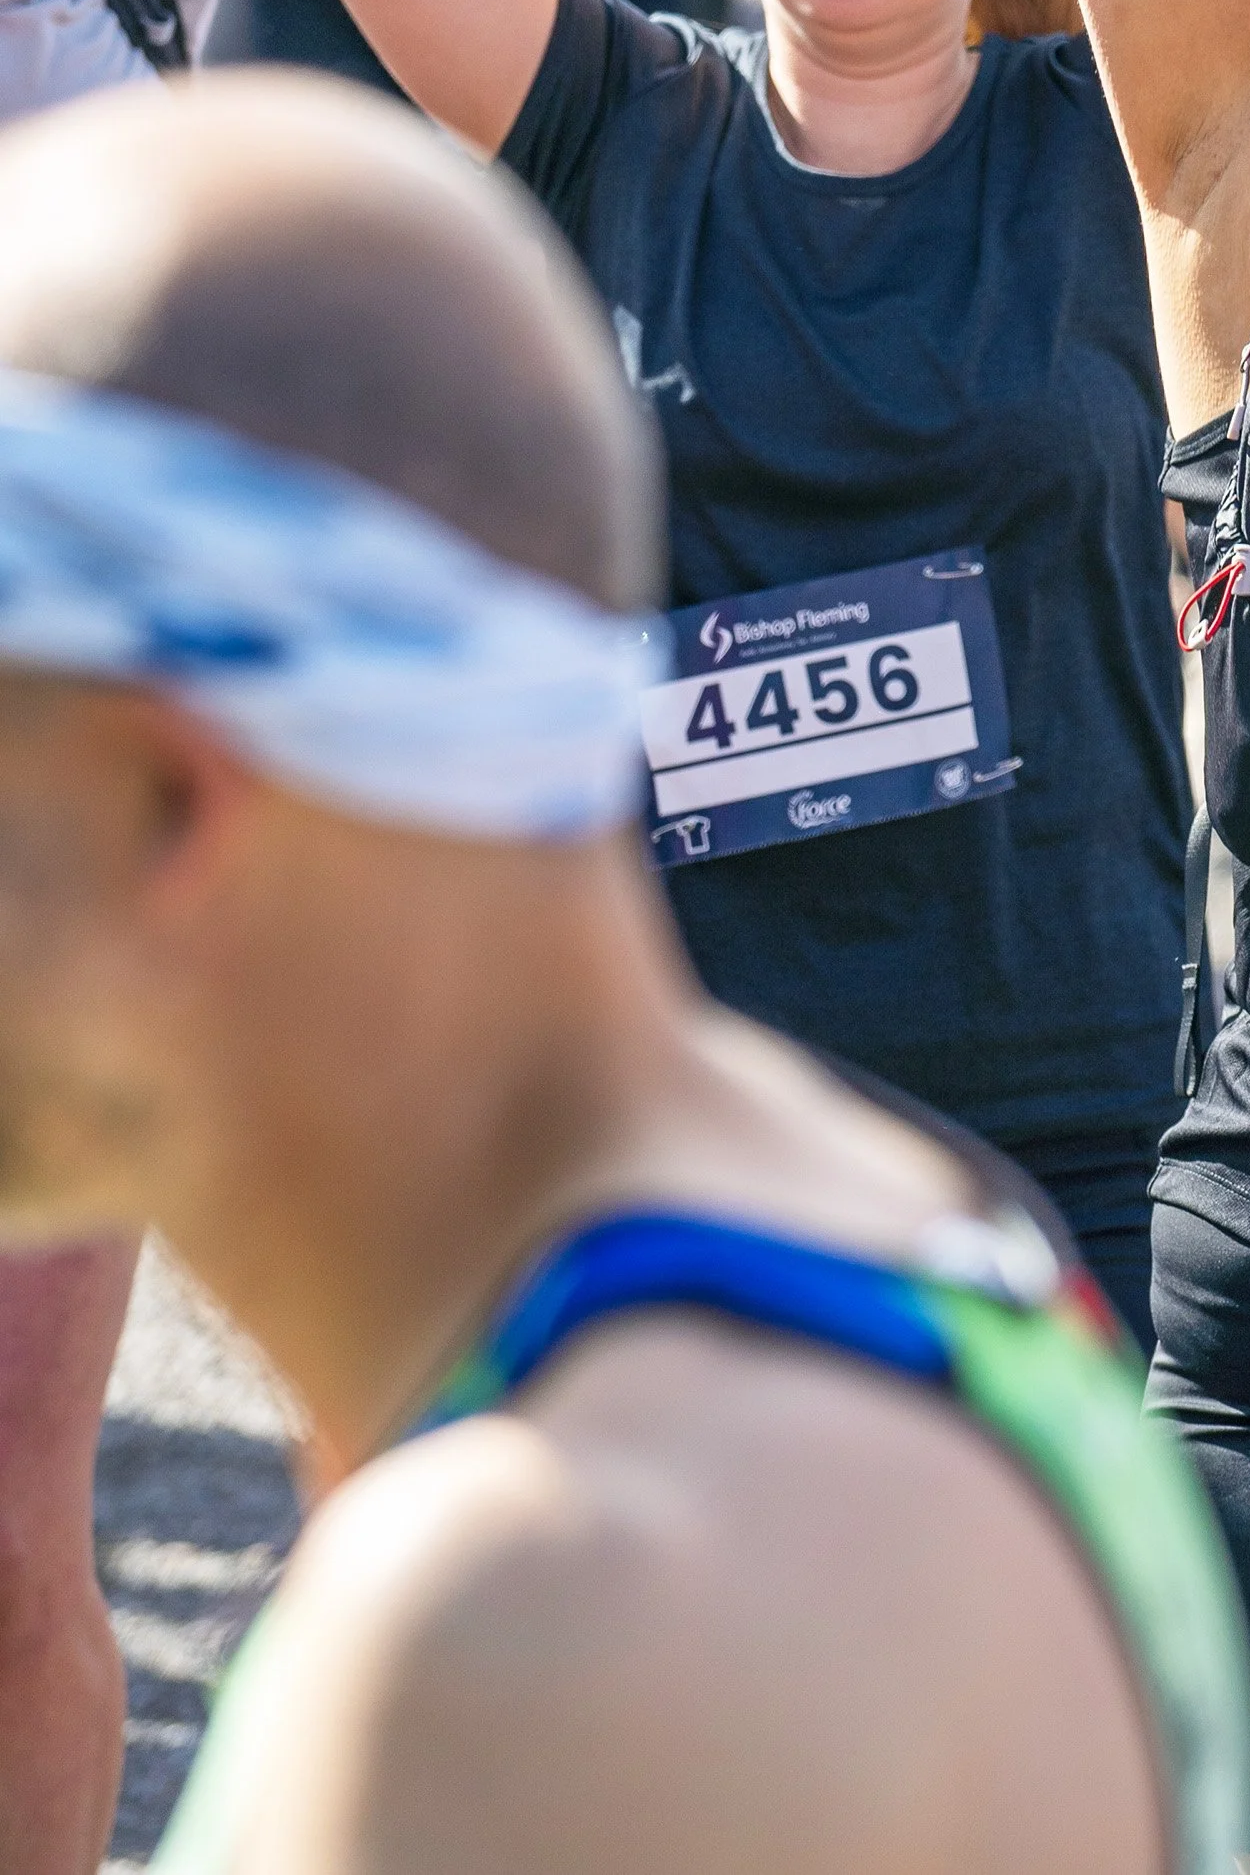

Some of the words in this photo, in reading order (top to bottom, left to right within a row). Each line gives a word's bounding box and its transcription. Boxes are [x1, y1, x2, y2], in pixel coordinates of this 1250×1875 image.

[733, 617, 796, 644] Bishop
[797, 601, 870, 631] Fleming
[685, 643, 919, 749] 4456
